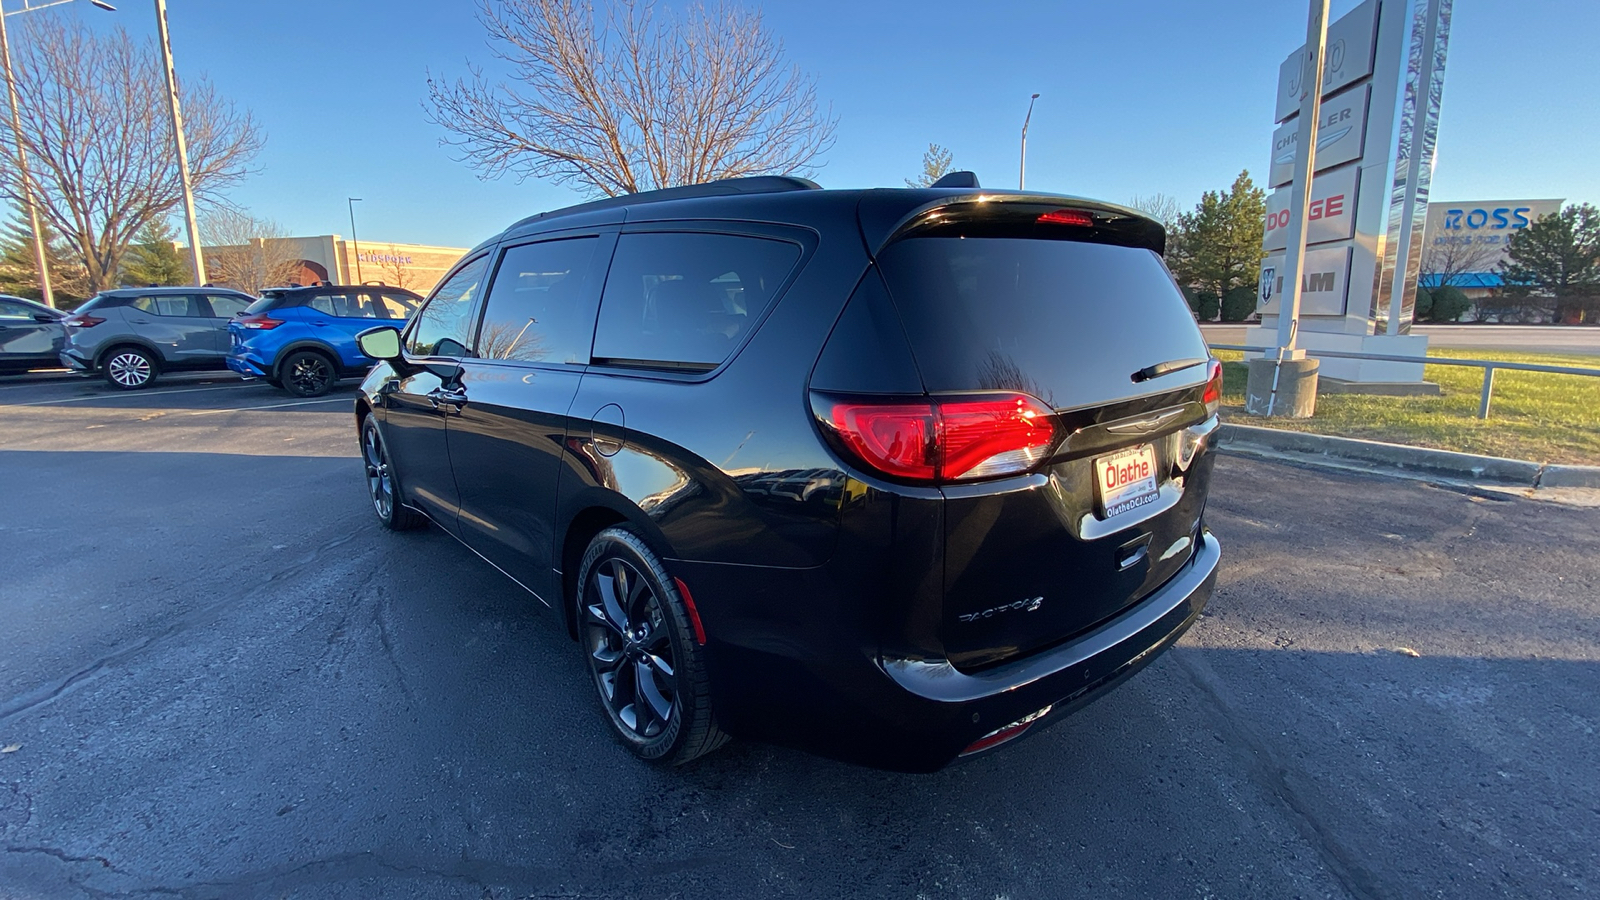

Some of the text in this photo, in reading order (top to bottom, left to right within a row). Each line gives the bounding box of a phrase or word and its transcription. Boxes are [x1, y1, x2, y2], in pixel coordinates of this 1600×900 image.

[1288, 38, 1345, 98] Jp
[1276, 108, 1352, 151] CHRLER
[1266, 194, 1344, 231] DOGE
[1445, 207, 1530, 230] ROSS
[1106, 459, 1149, 488] Olathe
[1107, 493, 1159, 518] OlatheDCJ.com
